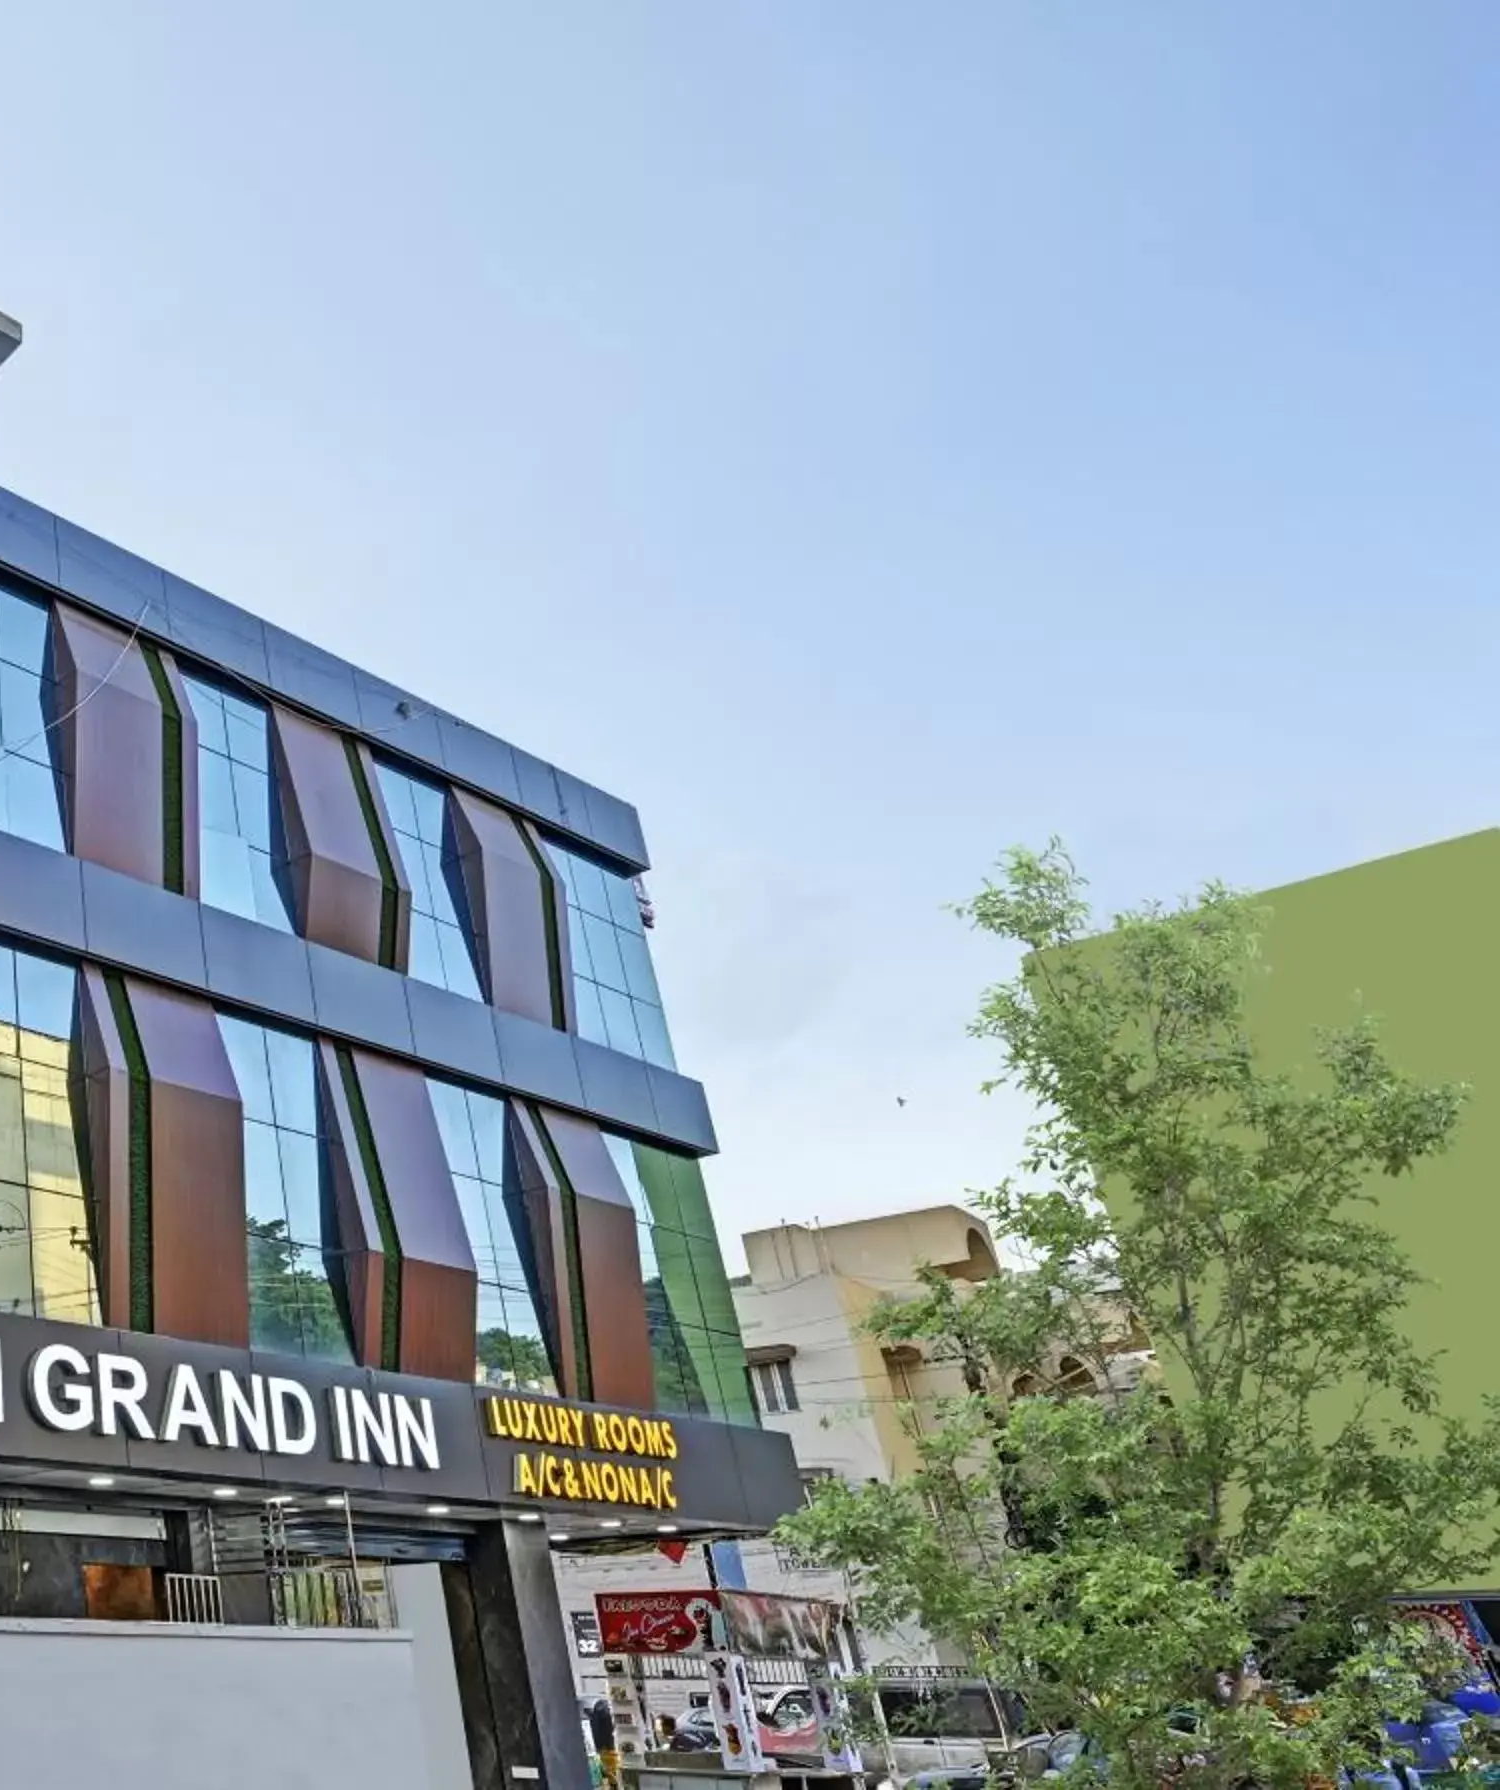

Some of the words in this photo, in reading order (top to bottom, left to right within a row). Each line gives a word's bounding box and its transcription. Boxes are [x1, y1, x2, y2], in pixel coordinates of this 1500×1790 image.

[30, 1342, 317, 1456] GRAND
[331, 1384, 442, 1471] INN
[489, 1394, 586, 1448] LUXURY
[592, 1411, 678, 1460] ROOMS
[577, 1639, 599, 1653] 32
